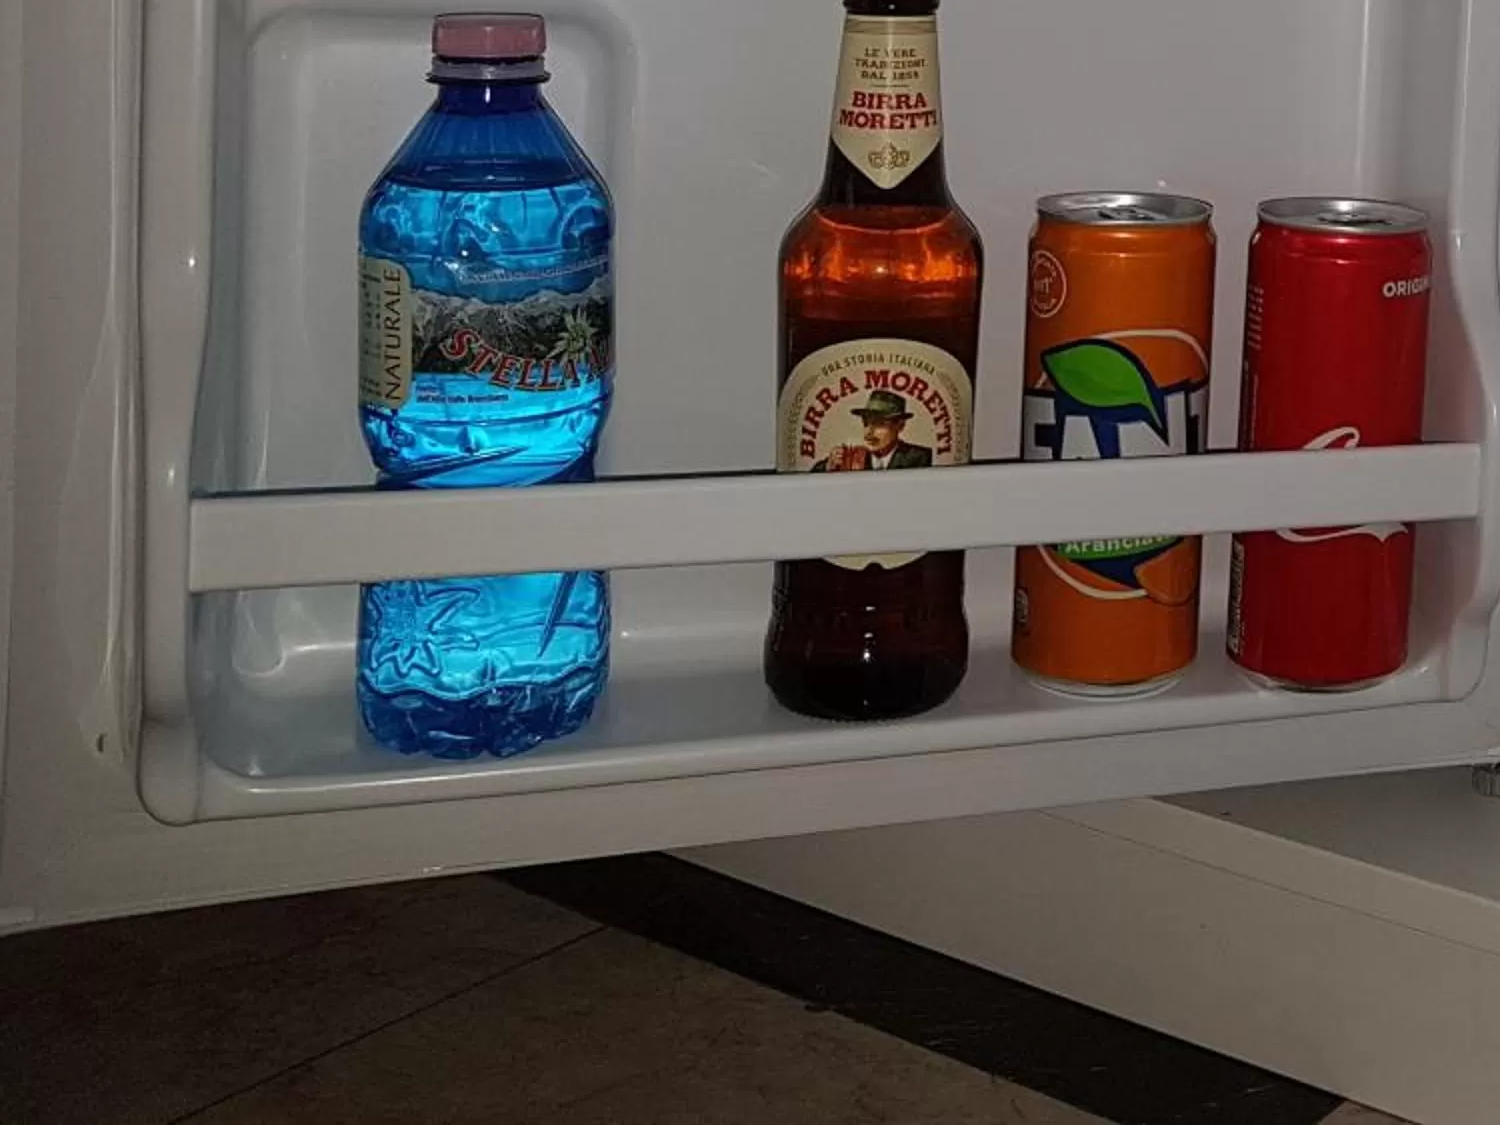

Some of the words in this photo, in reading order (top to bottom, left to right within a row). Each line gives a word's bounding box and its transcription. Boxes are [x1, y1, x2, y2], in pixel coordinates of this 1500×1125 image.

[863, 46, 881, 58] LE
[860, 70, 887, 81] DAL
[851, 90, 928, 110] BIRRA
[839, 108, 938, 130] MORETTI
[382, 268, 402, 401] NATURALE
[439, 327, 582, 392] STELLA
[843, 352, 885, 369] STORIA
[888, 352, 936, 376] ITALIANA
[800, 376, 859, 460] BIRRA
[863, 369, 953, 456] MORETTI
